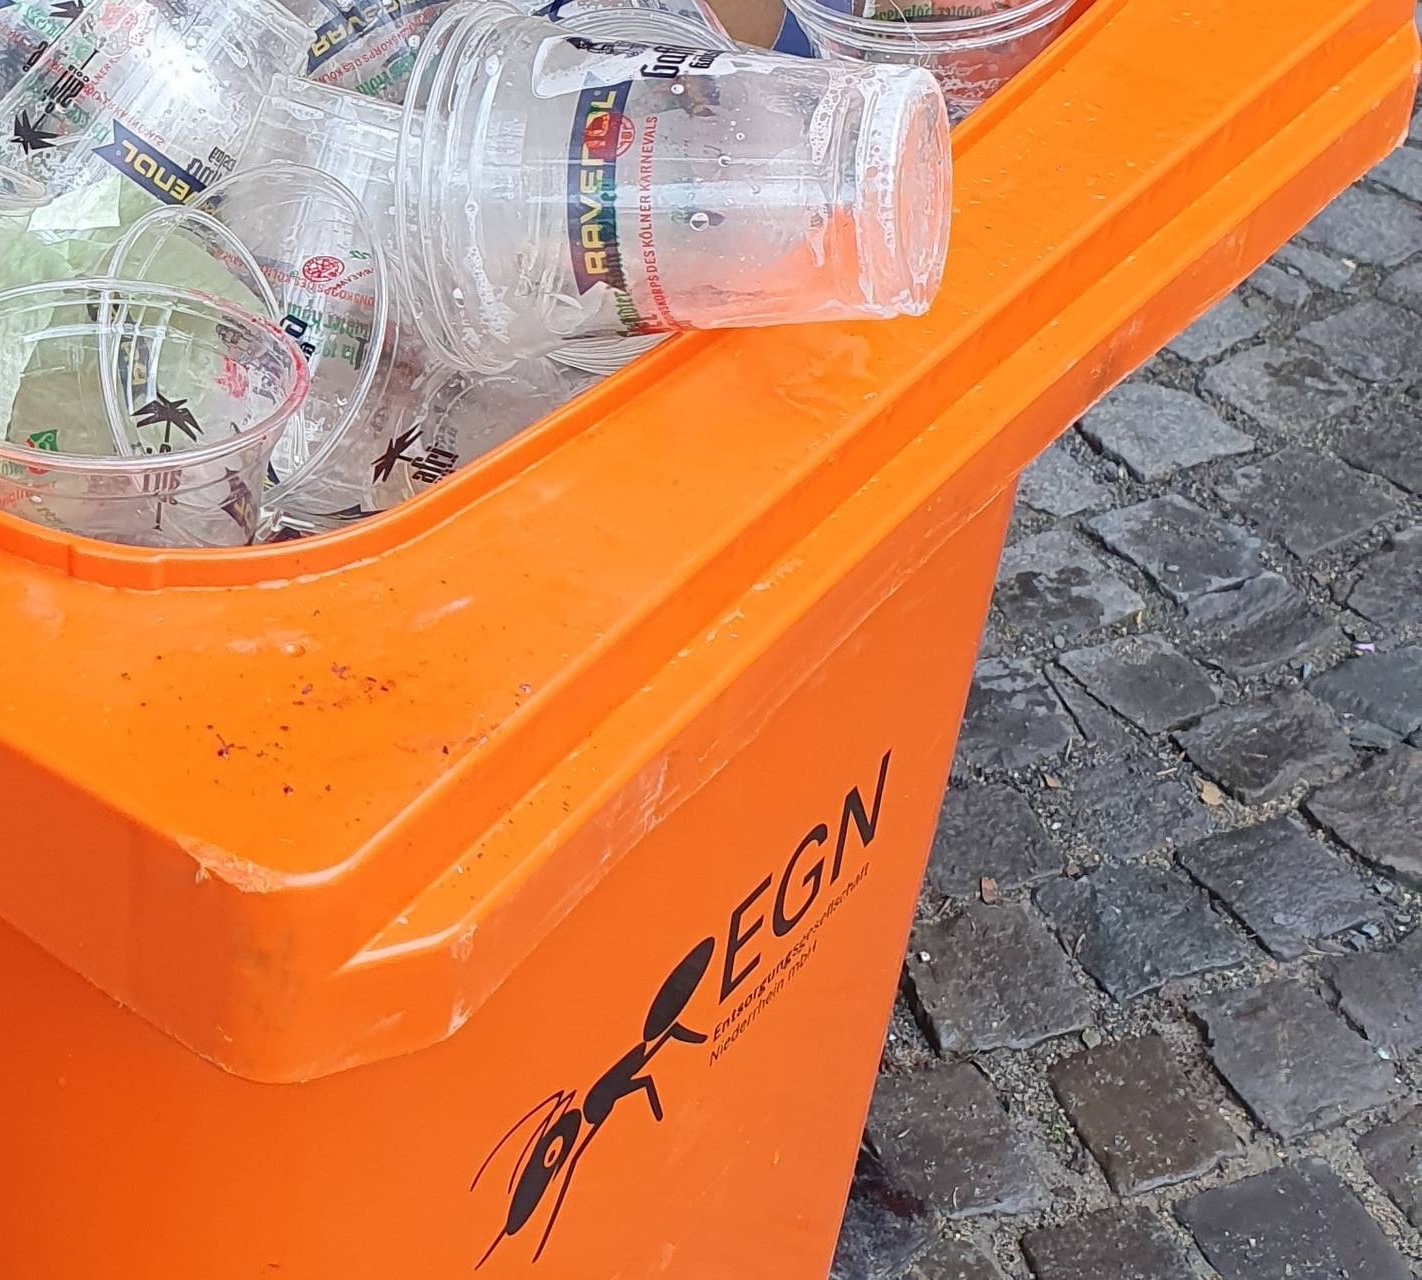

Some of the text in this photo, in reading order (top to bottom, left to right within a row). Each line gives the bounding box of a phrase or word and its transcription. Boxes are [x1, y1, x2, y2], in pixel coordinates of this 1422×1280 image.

[638, 115, 659, 191] KARNEVALS
[640, 193, 656, 248] KÖLNER
[643, 249, 657, 275] DES
[410, 440, 459, 484] afri
[718, 749, 892, 1006] EGN
[708, 938, 819, 1068] Niederrhein mbH
